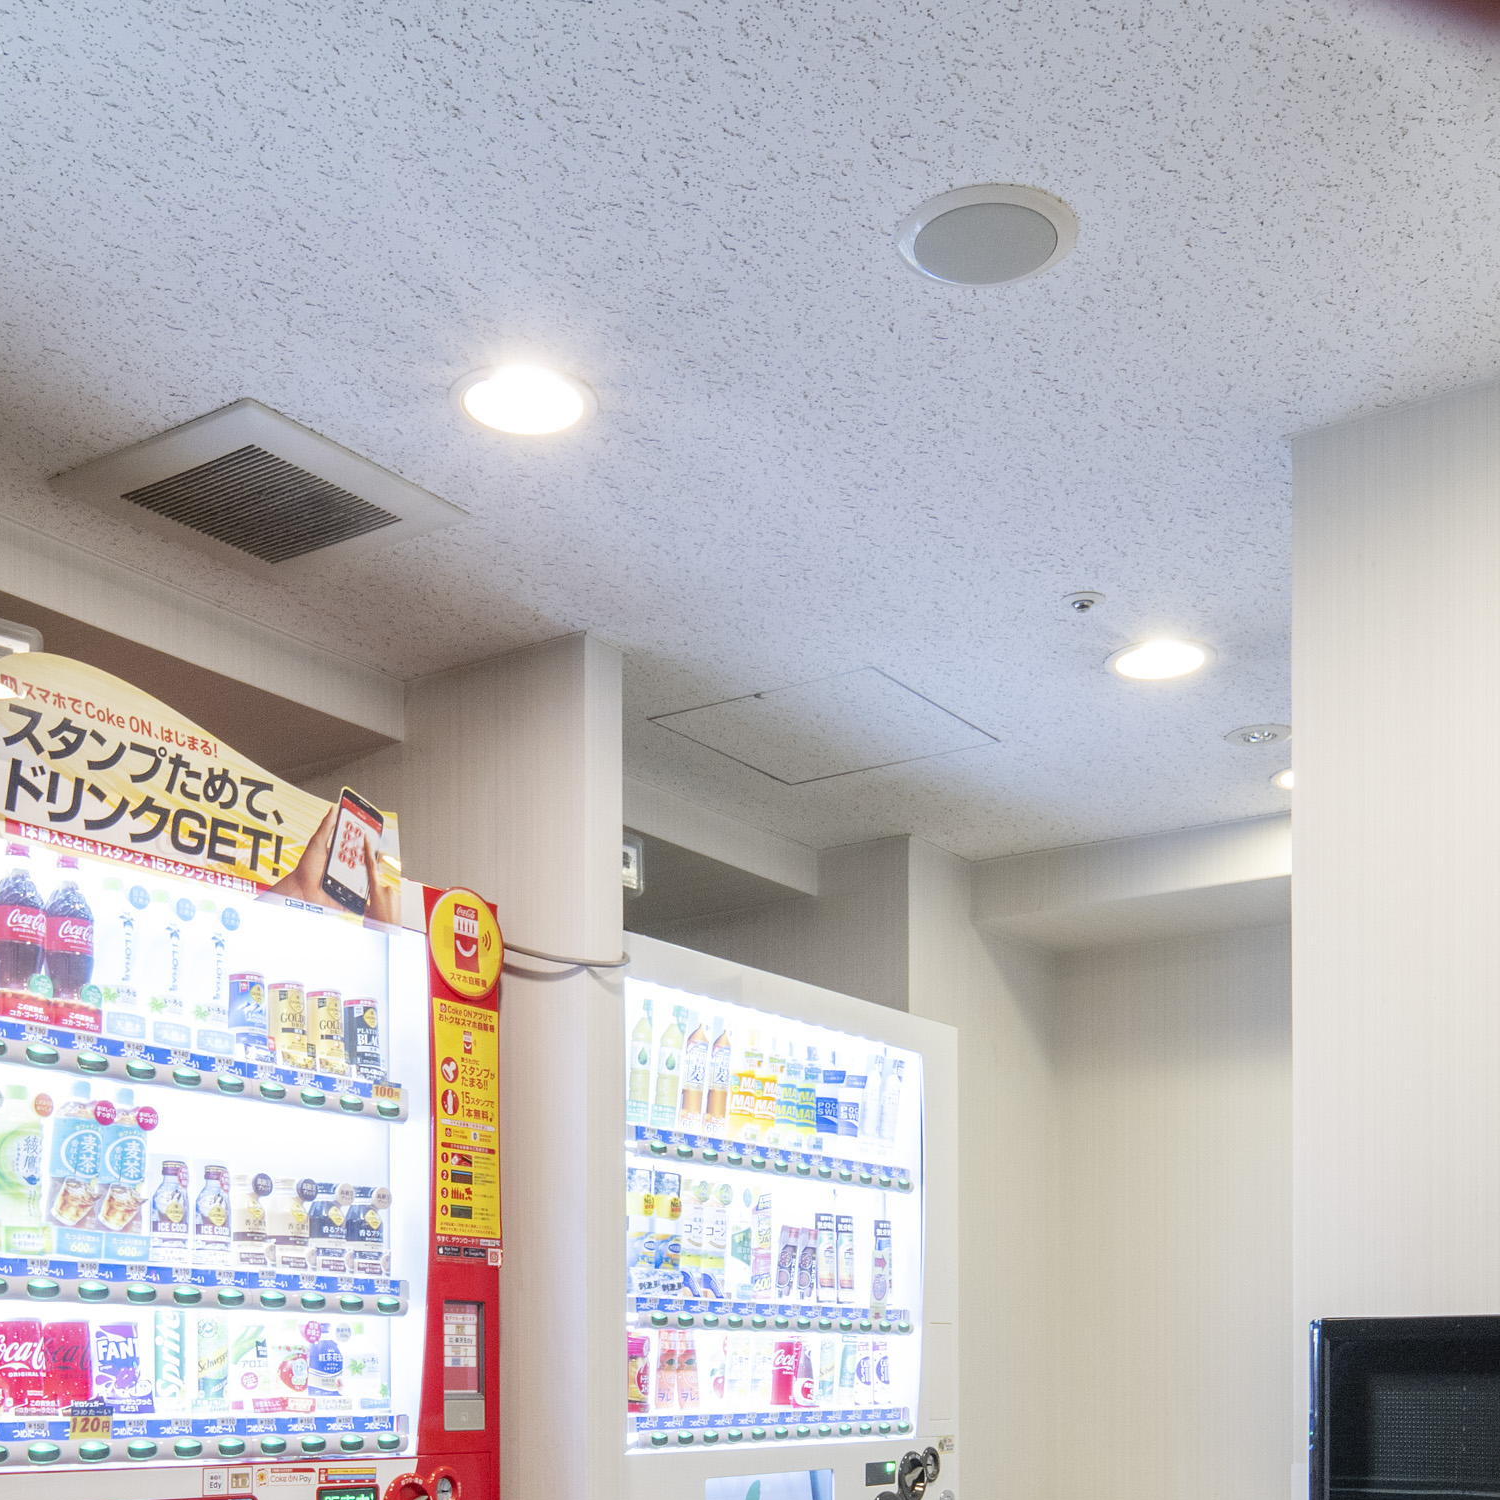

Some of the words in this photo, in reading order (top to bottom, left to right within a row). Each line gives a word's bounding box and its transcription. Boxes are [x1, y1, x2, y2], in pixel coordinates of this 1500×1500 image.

[3, 703, 284, 826] スタンプためて、
[4, 758, 283, 877] ドリンクGET!
[456, 906, 476, 919] Coca-Cola
[450, 972, 488, 988] スマホ自販機
[448, 1005, 462, 1016] Coke
[463, 1009, 493, 1022] ONアプリで
[438, 1014, 495, 1033] おトクなスマホ自販機
[461, 1065, 495, 1080] スタンプが
[461, 1076, 488, 1090] たまる!!
[374, 1086, 400, 1100] 100円
[461, 1091, 495, 1108] 15スタンプで
[80, 1134, 97, 1174] 麦茶
[124, 1140, 141, 1179] 麦茶
[155, 1309, 181, 1398] Sprite
[71, 1417, 111, 1433] 120円
[209, 1481, 222, 1490] Edy
[270, 1475, 287, 1483] Coke
[299, 1475, 312, 1484] Pay
